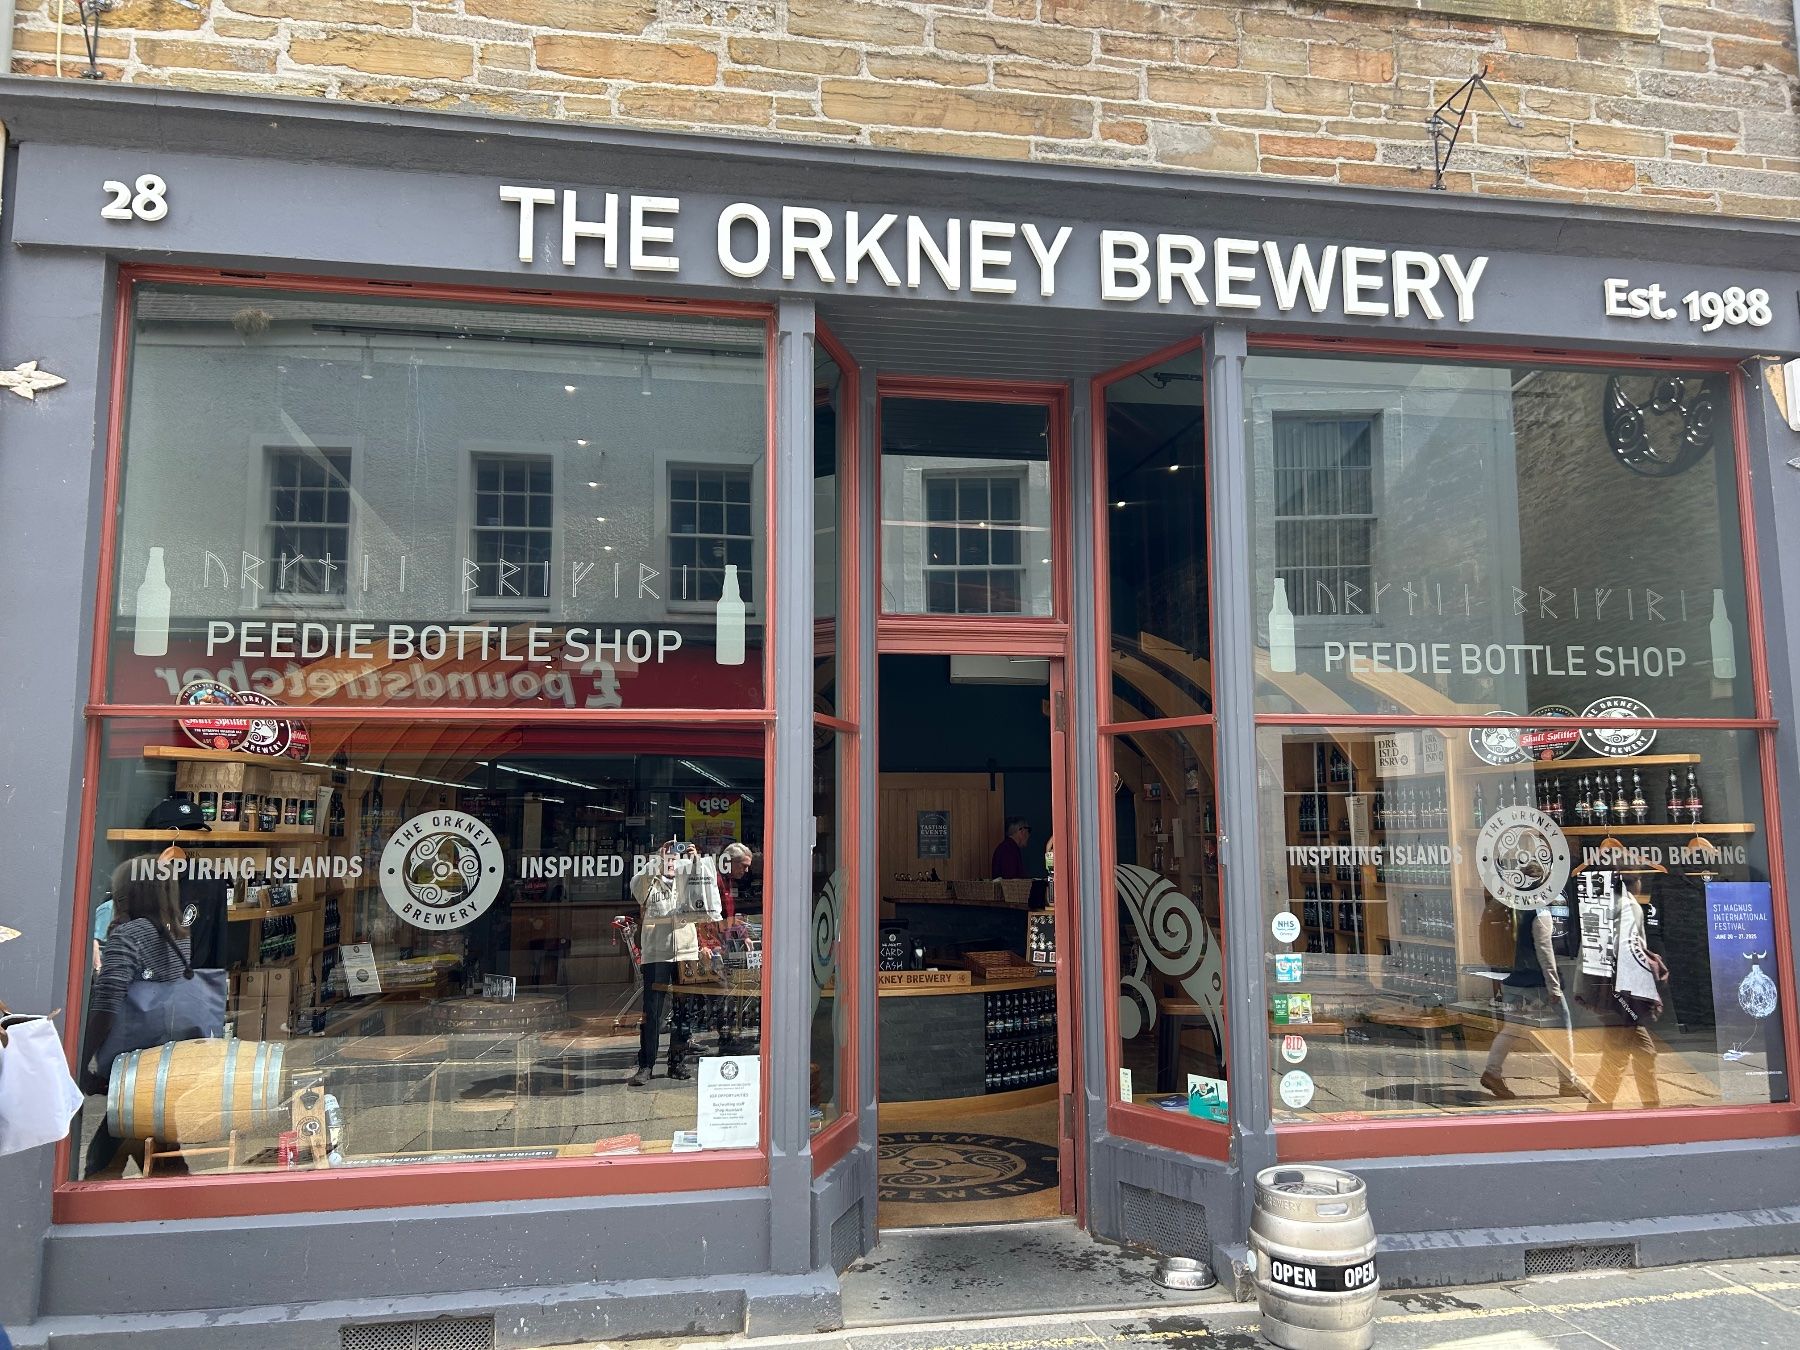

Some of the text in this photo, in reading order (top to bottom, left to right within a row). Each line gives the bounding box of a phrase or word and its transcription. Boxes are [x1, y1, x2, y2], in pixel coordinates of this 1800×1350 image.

[101, 174, 168, 221] 28
[499, 186, 1489, 323] THE ORKNEY BREWERY
[1604, 278, 1773, 333] Est. 1988
[207, 621, 683, 664] PEEDIE BOTTLE SHOP
[1324, 641, 1686, 677] PEEDIE BOTTLE SHOP
[1599, 700, 1640, 711] ORKNEY
[1378, 739, 1398, 749] DRK
[1546, 729, 1579, 744] Splitter
[1603, 735, 1648, 753] BREWERY
[394, 816, 492, 848] THE ORKNEY
[1485, 811, 1558, 838] THE ORKNEY
[521, 853, 732, 879] INSPIRED BREWING
[1290, 845, 1462, 867] INSPIRING ISLANDS
[1582, 845, 1747, 867] INSPIRED BREWING
[130, 855, 364, 881] INSPIRING ISLANDS
[1497, 885, 1553, 906] BREWERY
[402, 901, 479, 925] BREWERY
[1713, 903, 1752, 912] ST MAGNUS
[1713, 913, 1768, 921] INTERNATIONAL
[1277, 920, 1295, 928] NHS
[1714, 922, 1746, 931] FESTIVAL
[880, 947, 904, 957] CARD
[879, 961, 903, 971] CASH
[878, 973, 952, 984] KNEY BREWERY
[1285, 1036, 1303, 1050] BID
[879, 1134, 1027, 1149] ORKNEY
[879, 1178, 1044, 1200] REWERY
[1272, 1261, 1317, 1288] OPEN
[1344, 1260, 1375, 1288] OPEN
